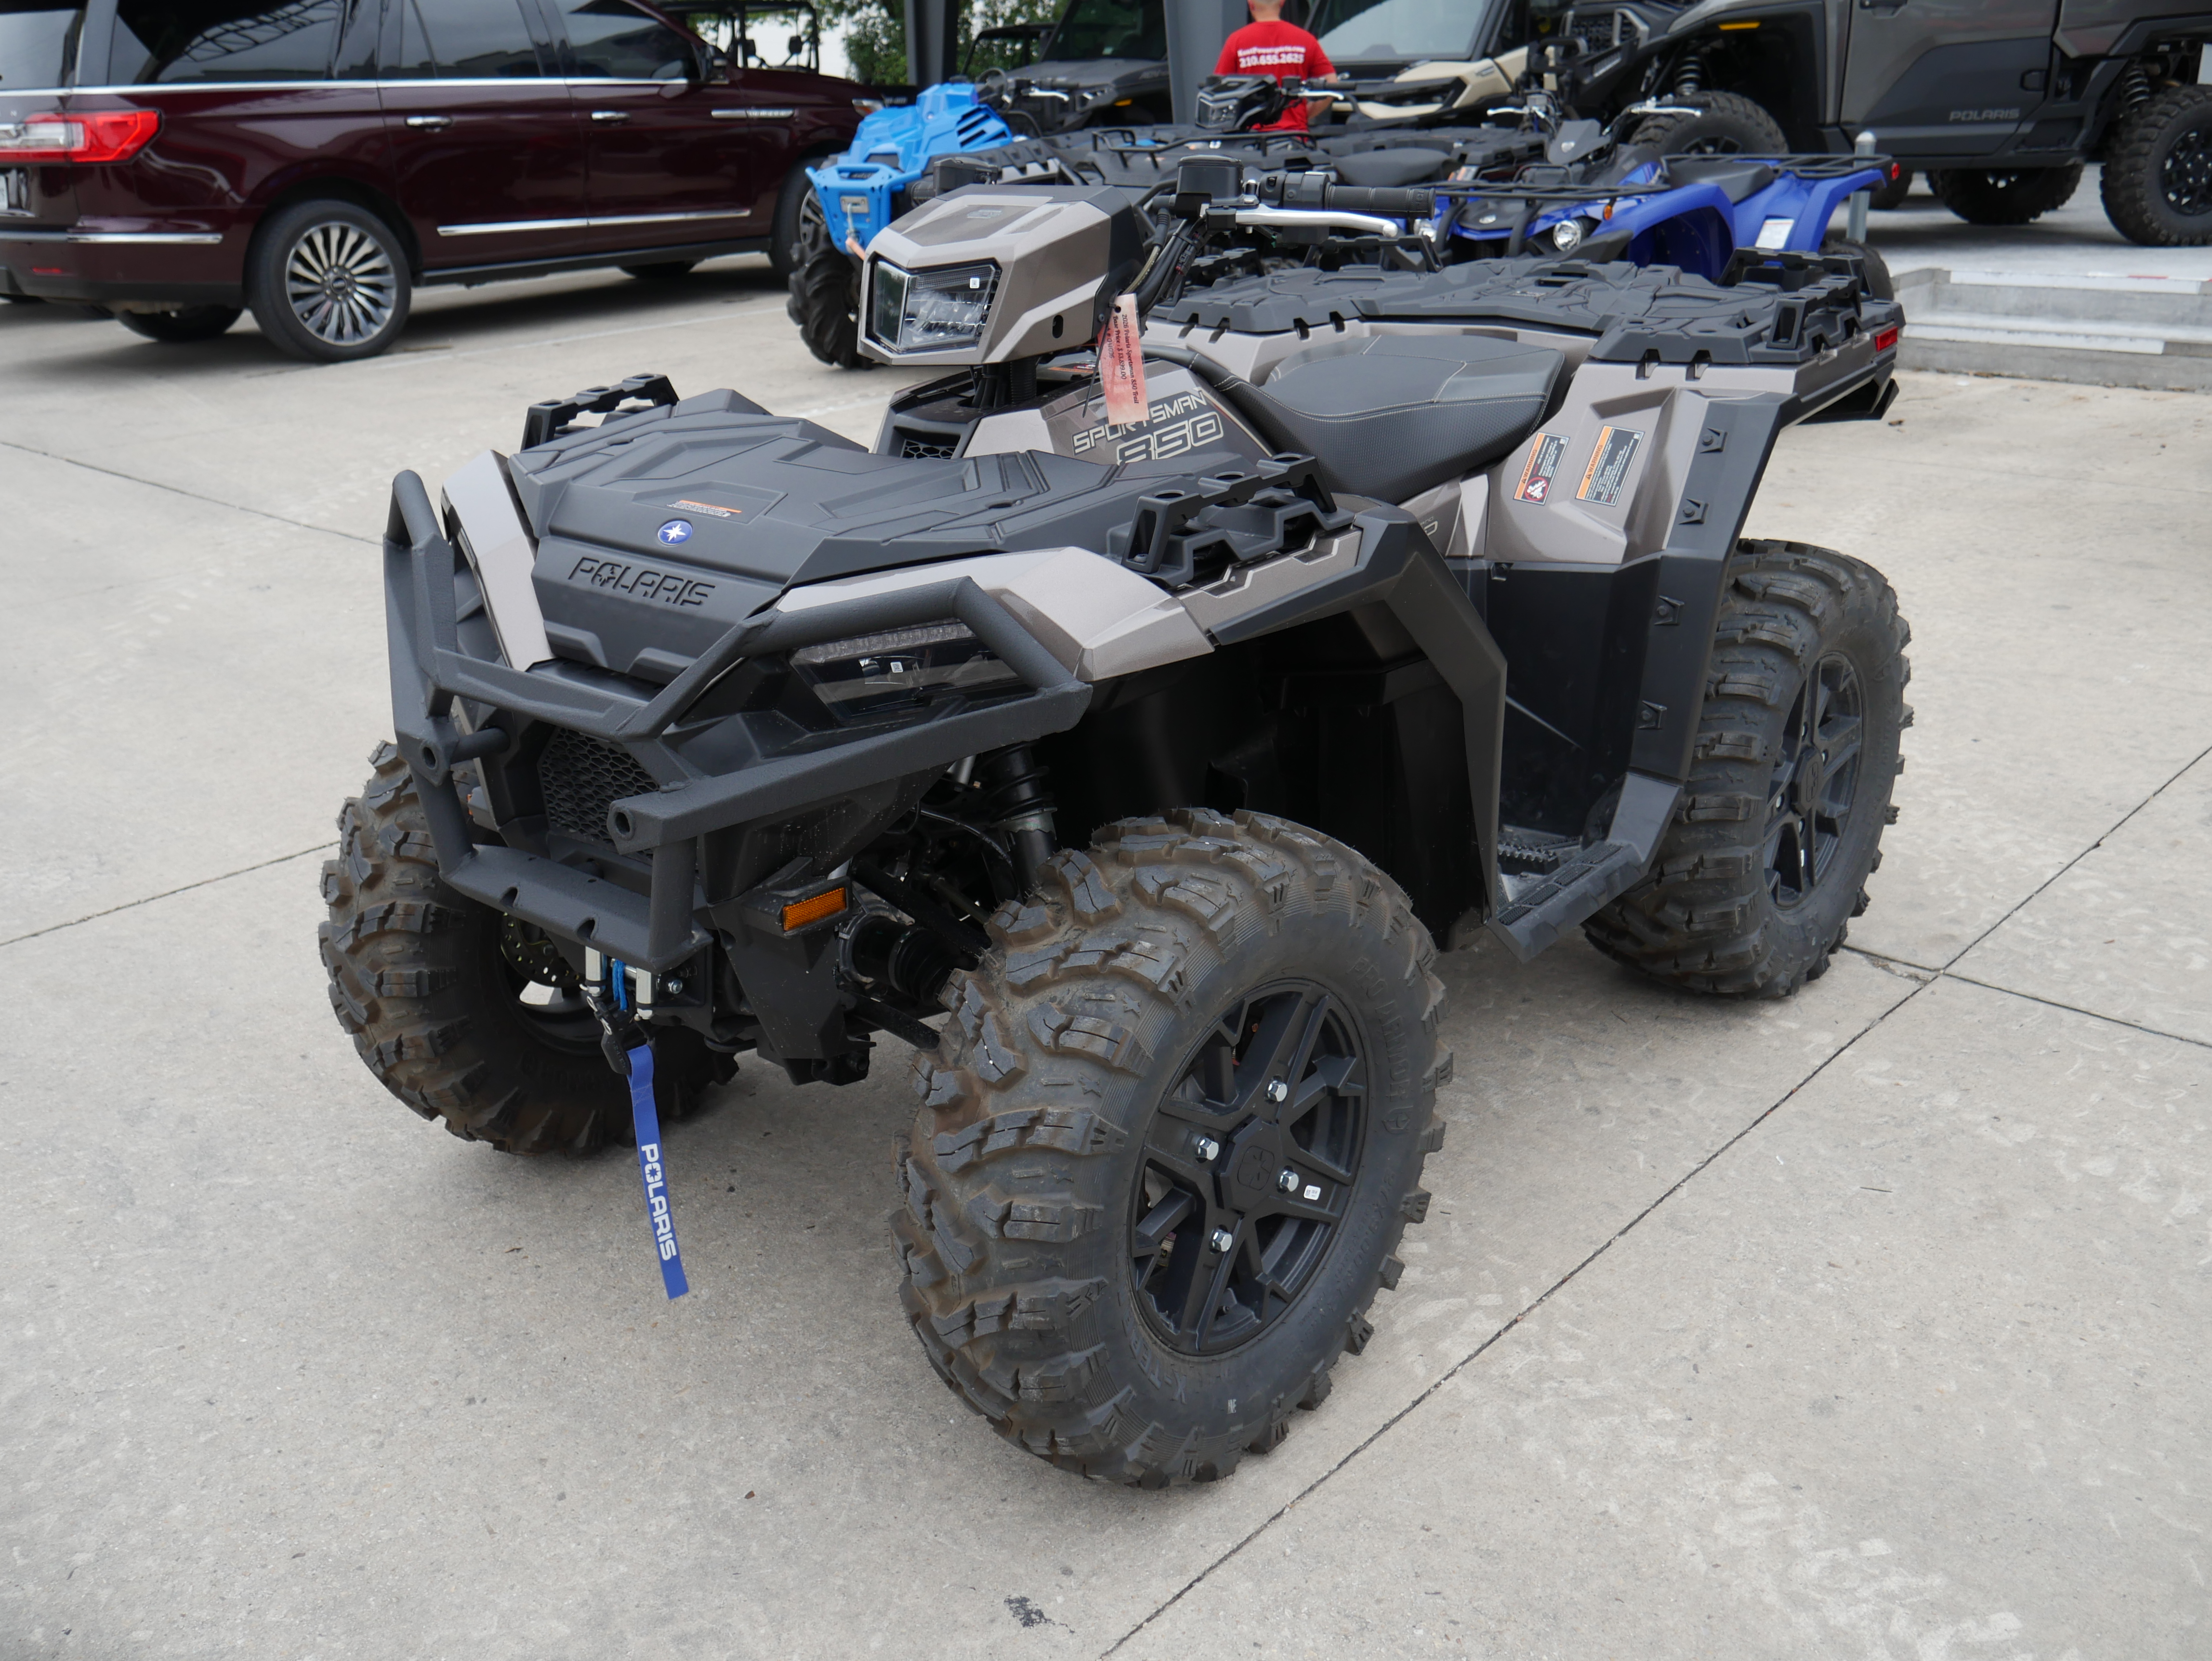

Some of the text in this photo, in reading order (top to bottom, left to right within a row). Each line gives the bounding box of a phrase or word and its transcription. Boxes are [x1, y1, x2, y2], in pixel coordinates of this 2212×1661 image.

[1949, 109, 2020, 121] POLARIS
[1126, 349, 1134, 378] Sportsman
[1116, 411, 1224, 466] 850
[1523, 449, 1537, 478] WARNING
[1588, 445, 1603, 473] WARNING
[568, 557, 715, 606] POLARIS
[641, 1143, 677, 1261] POLARIS
